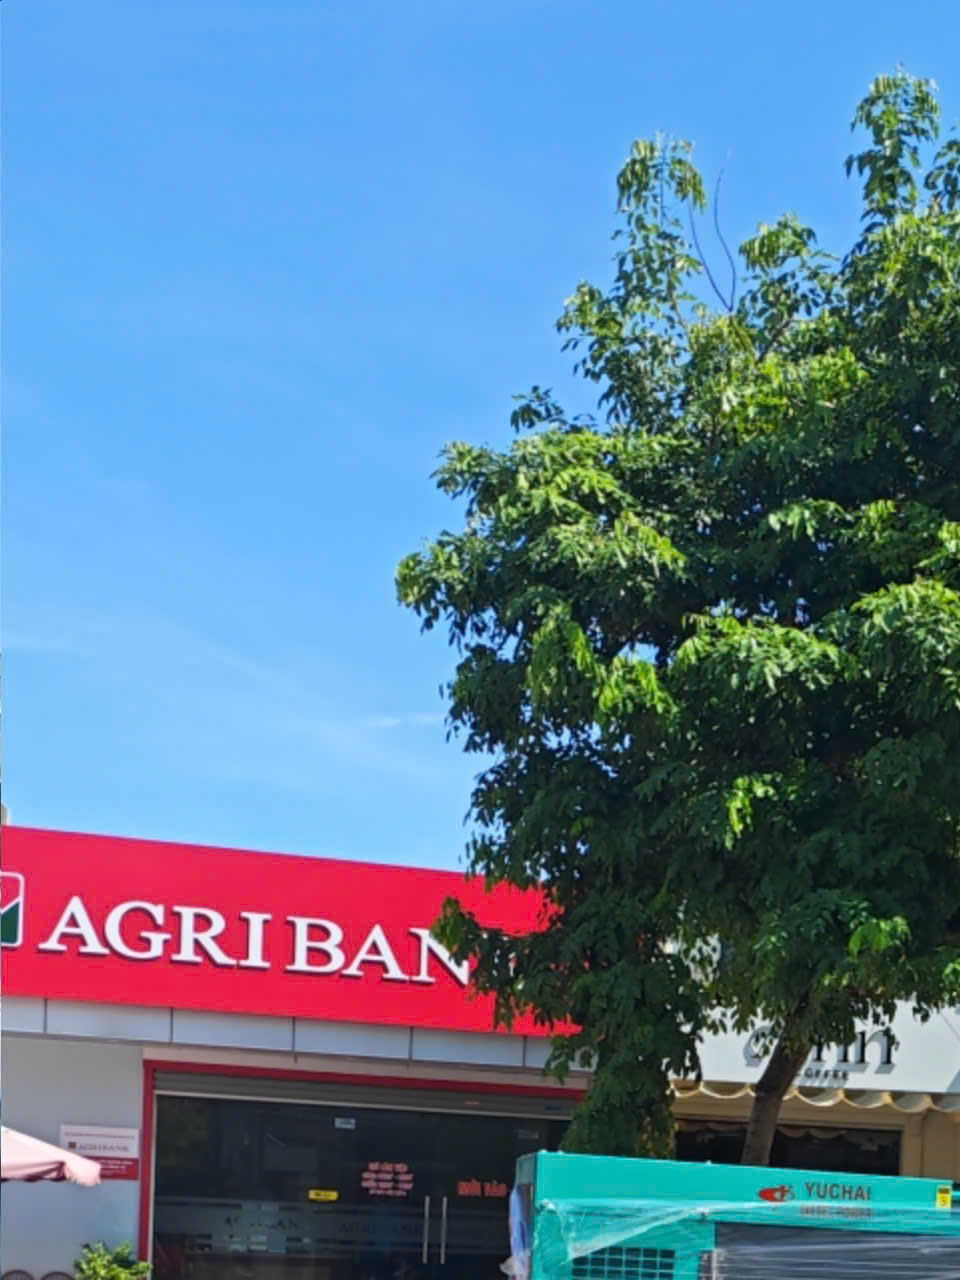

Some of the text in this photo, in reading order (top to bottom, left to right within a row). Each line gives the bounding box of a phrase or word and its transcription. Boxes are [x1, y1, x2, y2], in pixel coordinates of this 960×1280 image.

[38, 895, 472, 985] AGRIBAN
[803, 1067, 849, 1081] OFFEE
[803, 1181, 872, 1200] YUCHAI
